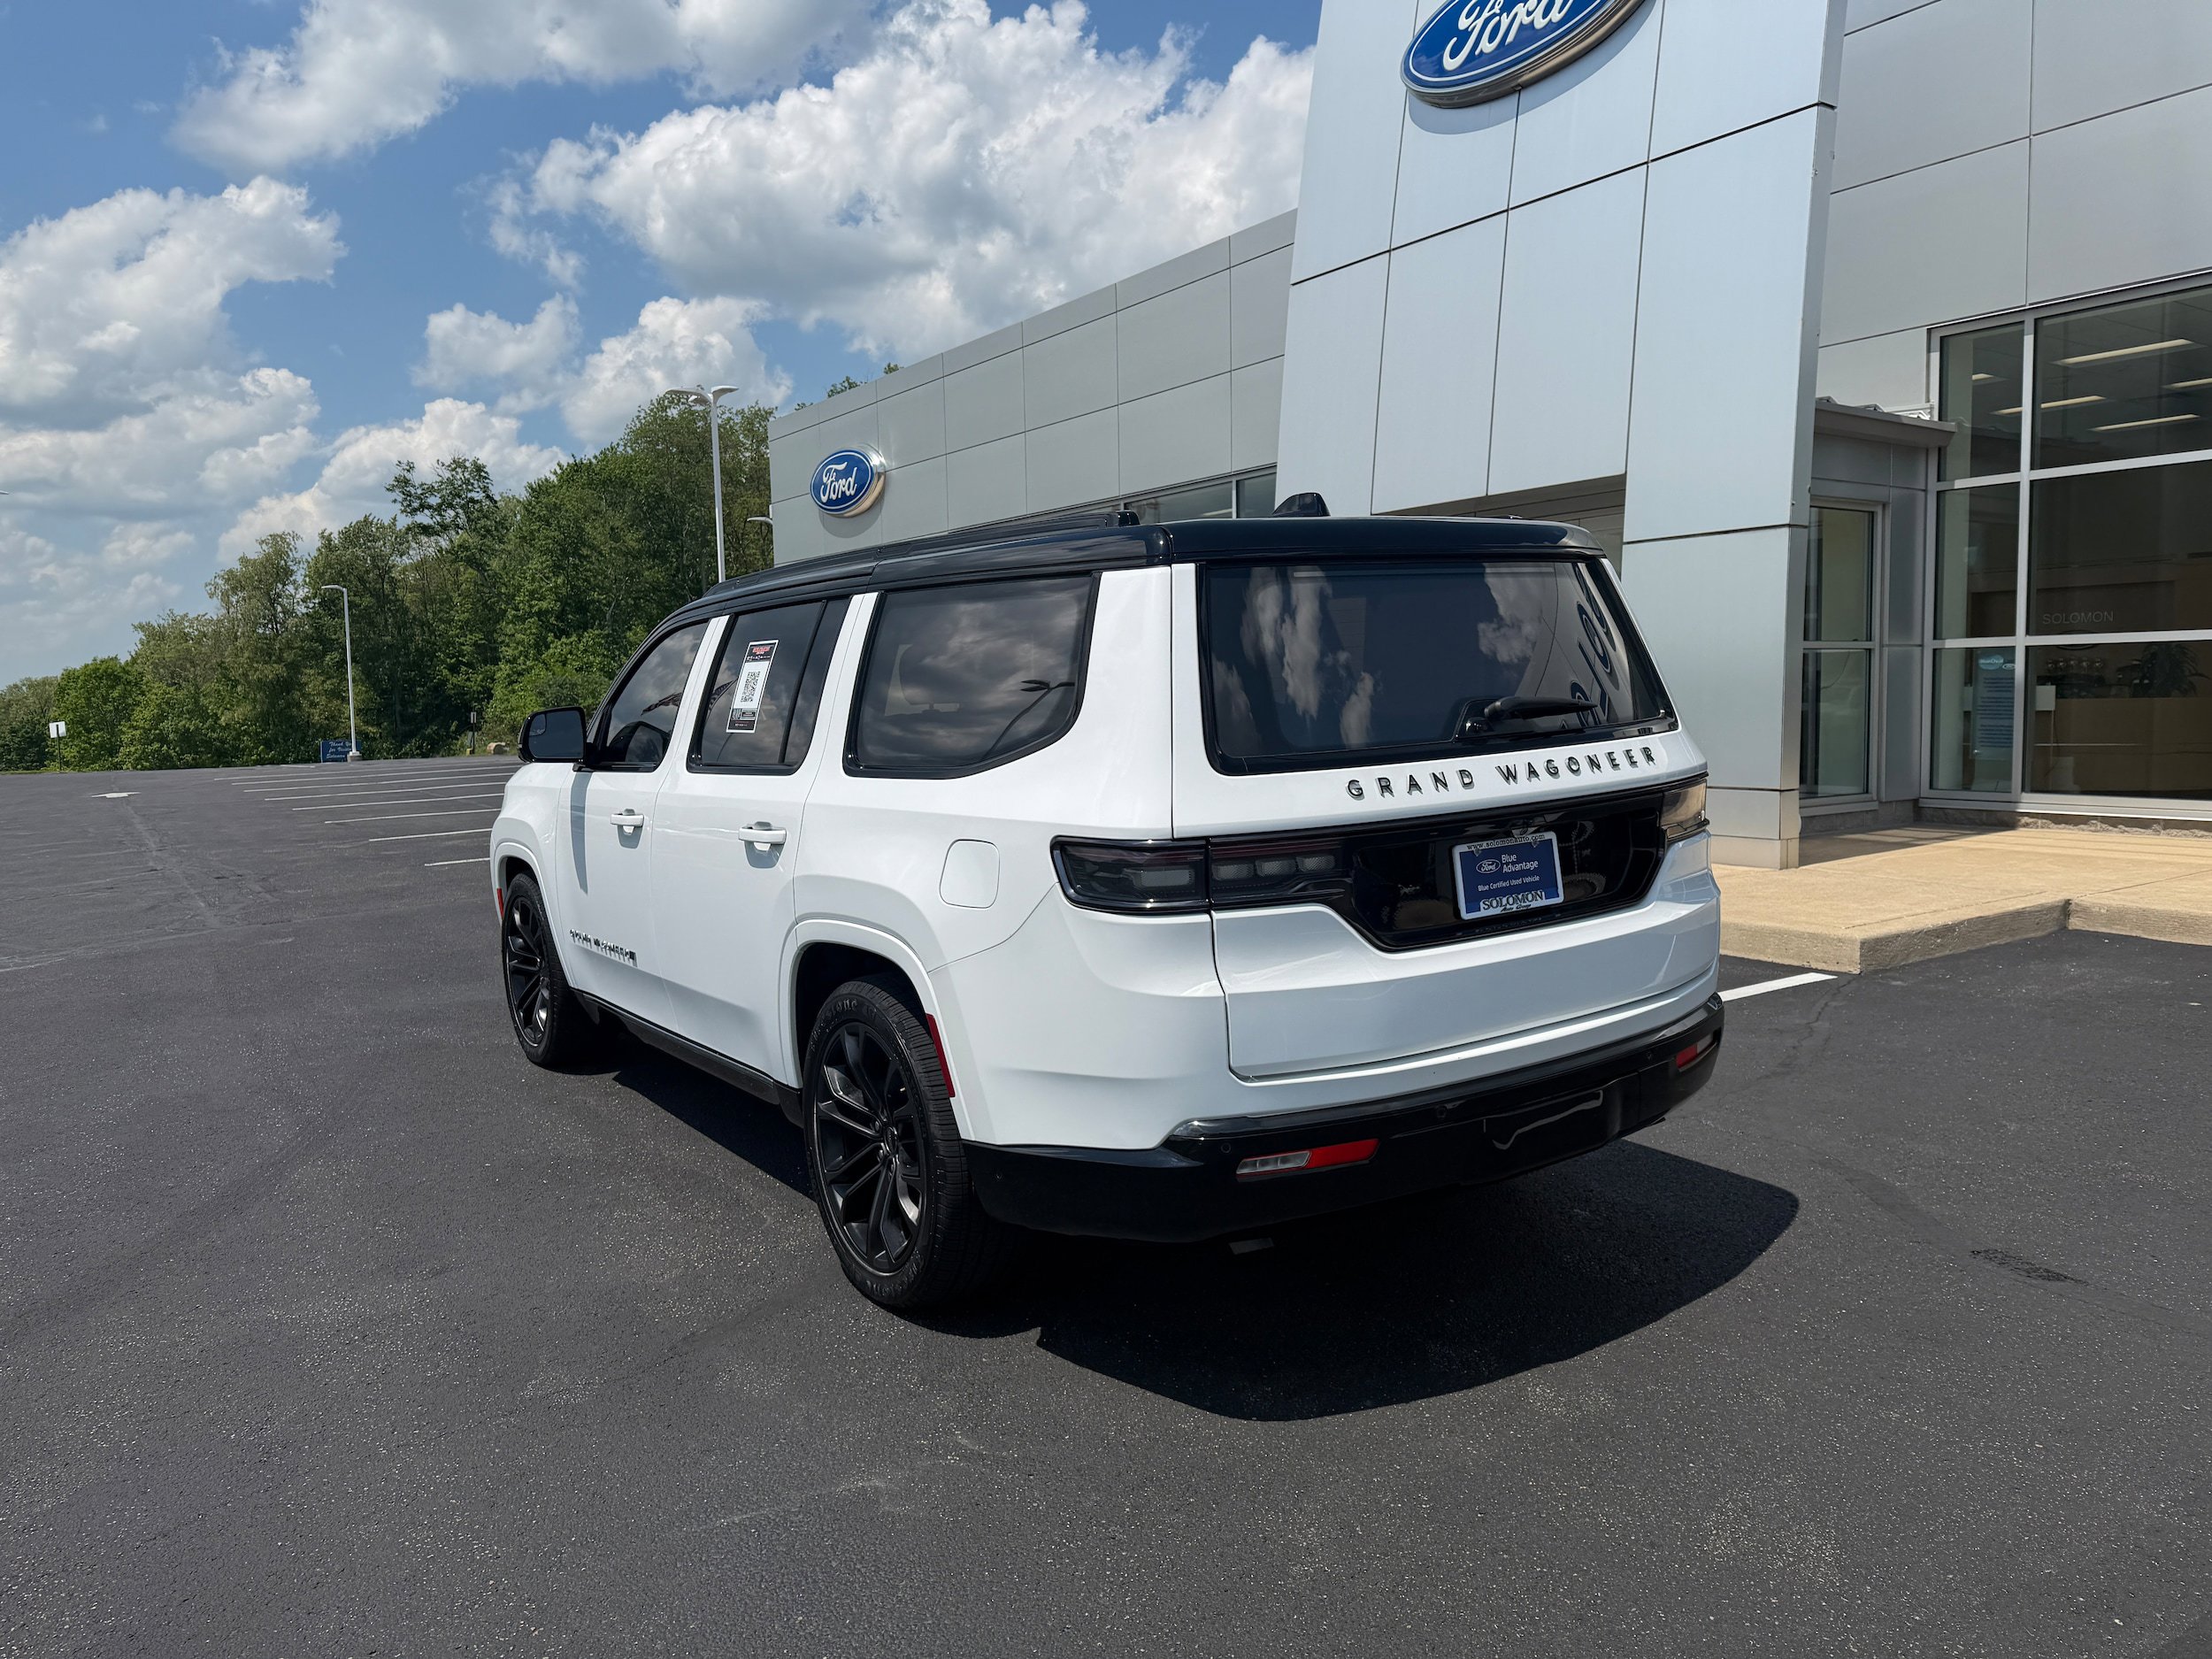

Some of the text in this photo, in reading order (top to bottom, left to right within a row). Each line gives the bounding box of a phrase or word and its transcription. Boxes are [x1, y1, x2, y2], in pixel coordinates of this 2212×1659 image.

[820, 462, 858, 503] Ford
[2042, 611, 2115, 625] SOLOMON
[1346, 746, 1657, 800] GRAND WAGONEER
[1466, 833, 1546, 850] www.solomonauto.com
[1480, 861, 1497, 872] Ford
[1502, 854, 1517, 864] Blue
[1502, 859, 1539, 874] Advantage
[1489, 880, 1509, 889] Certified
[1522, 874, 1540, 883] Vehicle
[1482, 890, 1544, 910] SOLOMON
